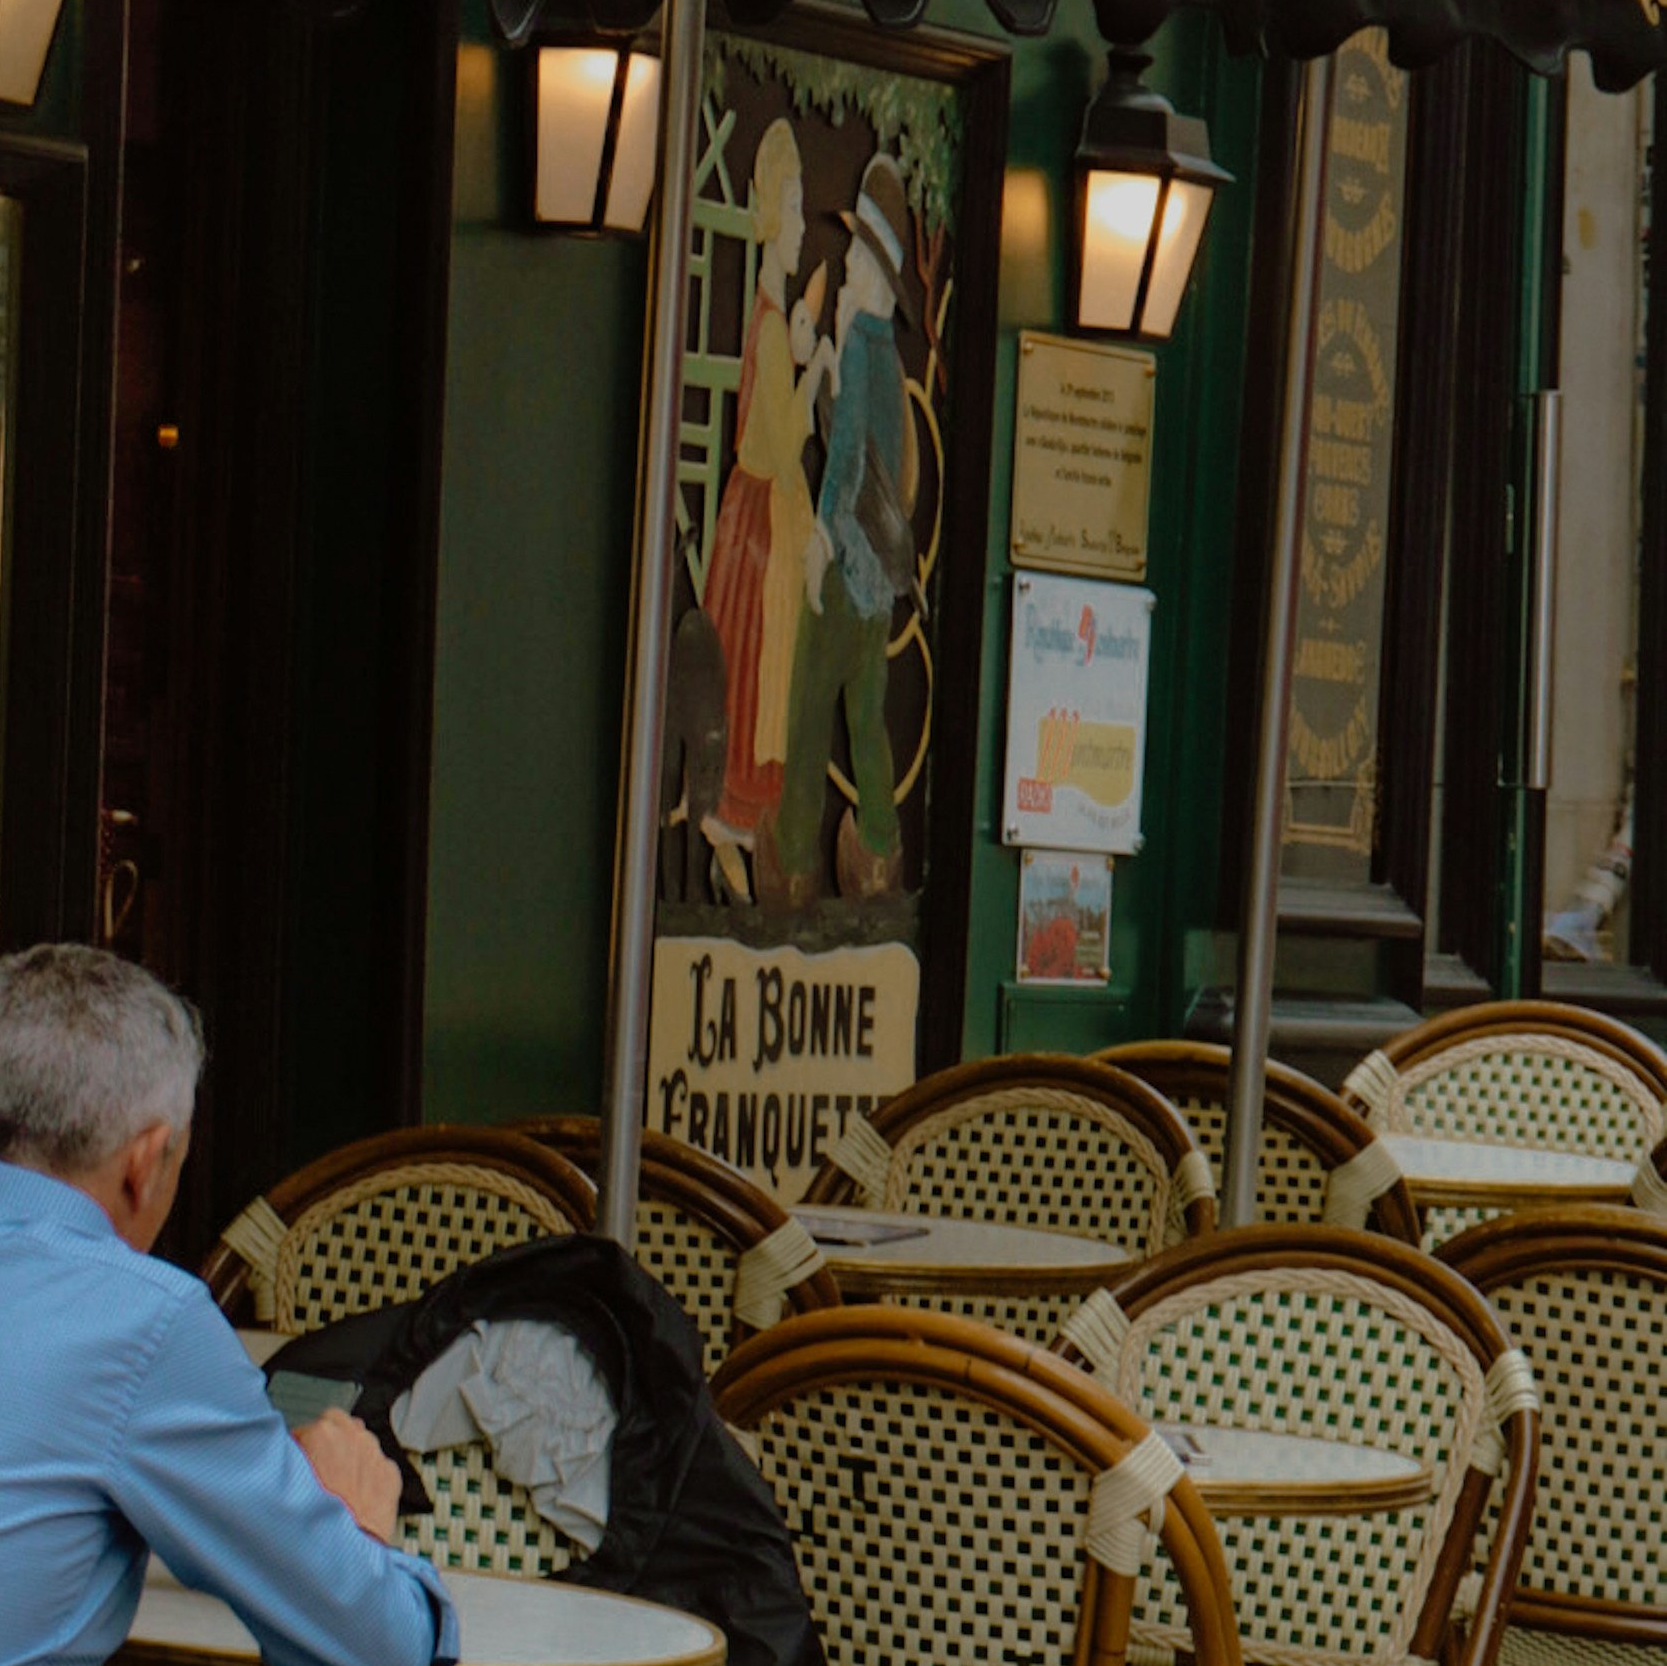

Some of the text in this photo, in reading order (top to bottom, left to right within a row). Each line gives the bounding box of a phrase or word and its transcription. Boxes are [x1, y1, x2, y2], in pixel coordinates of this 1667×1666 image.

[687, 952, 876, 1074] LA BONNE
[658, 1067, 897, 1189] FRANQUET
